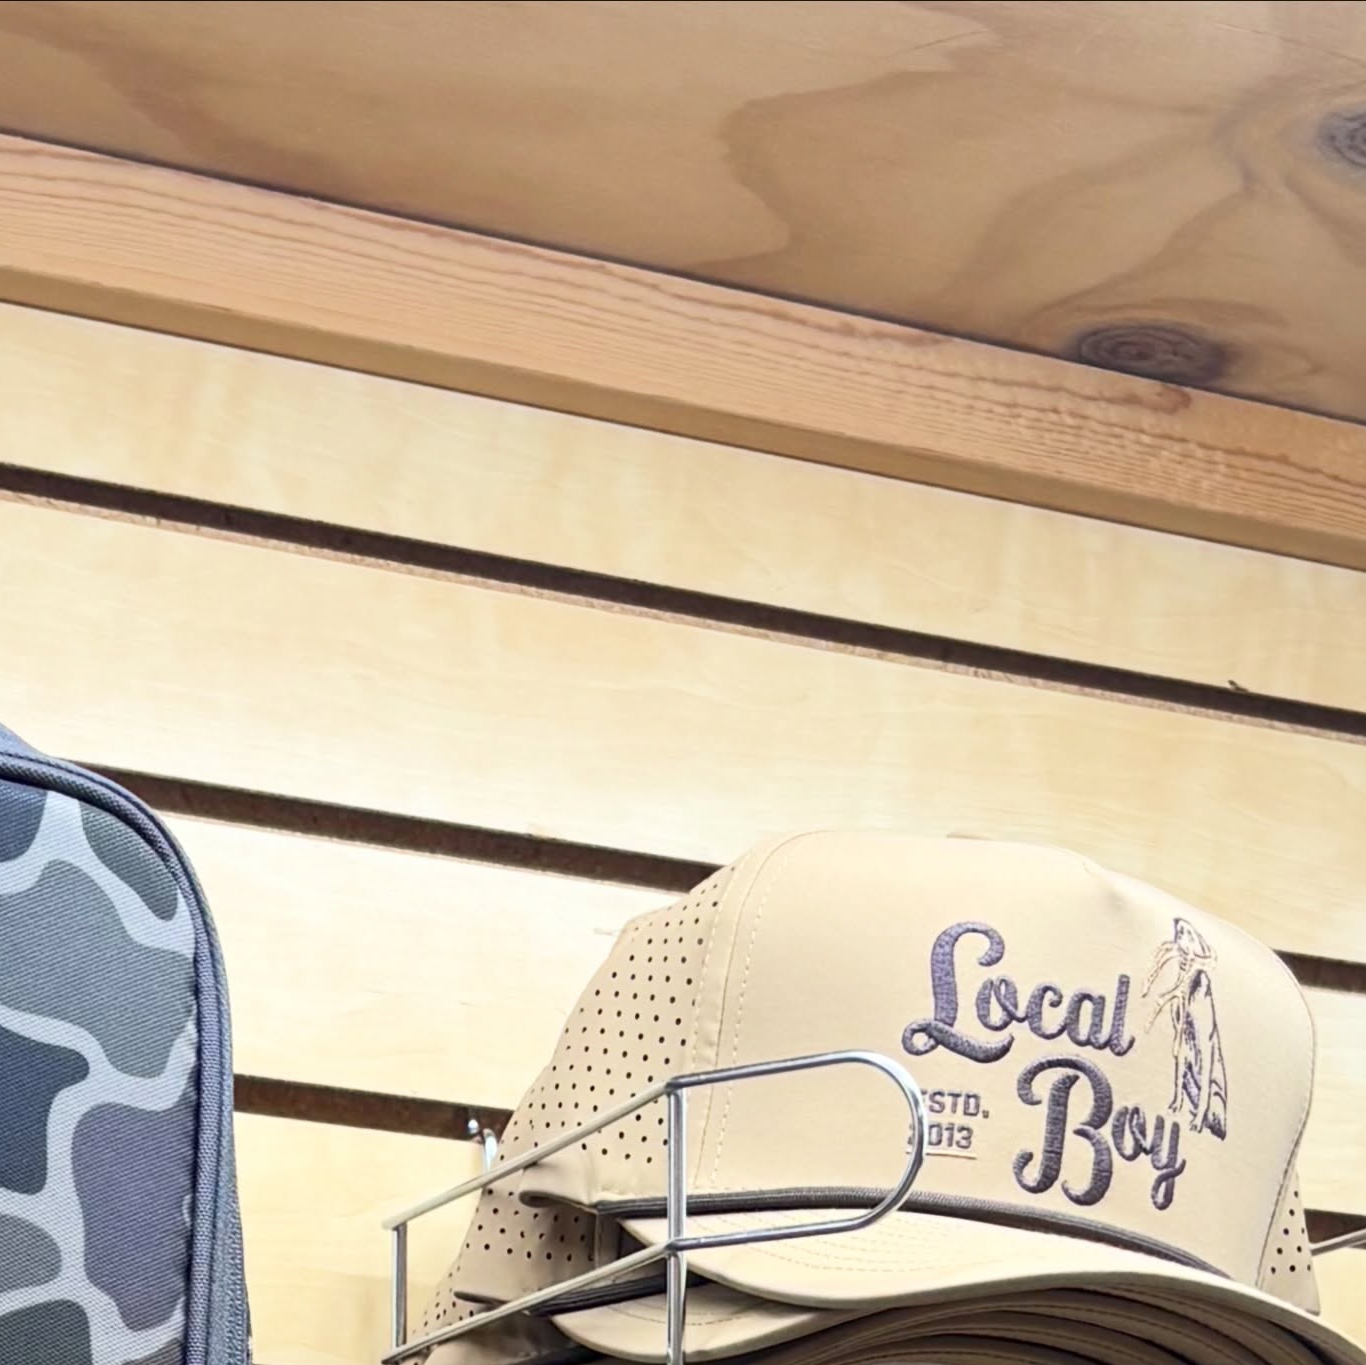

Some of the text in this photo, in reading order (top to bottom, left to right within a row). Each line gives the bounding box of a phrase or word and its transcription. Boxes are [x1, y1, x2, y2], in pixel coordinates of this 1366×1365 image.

[902, 922, 1135, 1063] Local
[907, 1122, 973, 1149] 013
[921, 1088, 989, 1119] STD.
[1013, 1055, 1186, 1210] Boy
